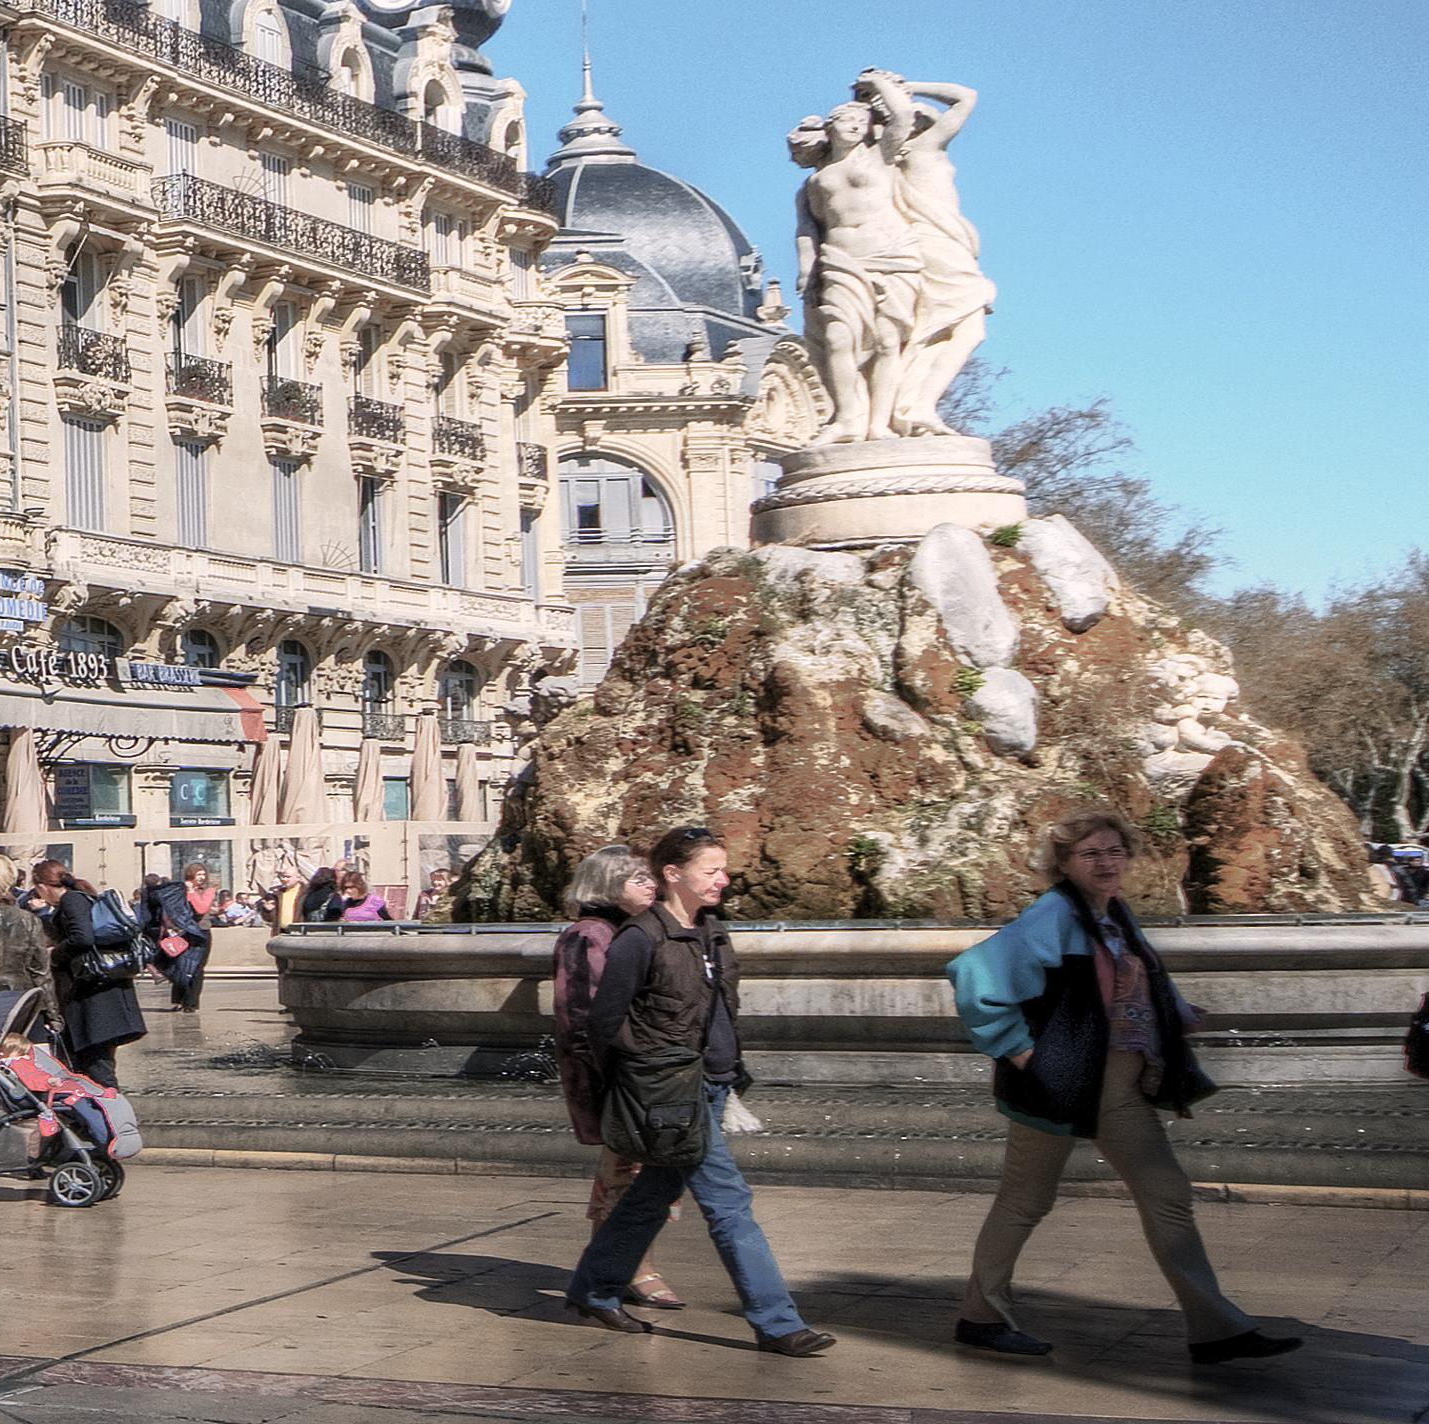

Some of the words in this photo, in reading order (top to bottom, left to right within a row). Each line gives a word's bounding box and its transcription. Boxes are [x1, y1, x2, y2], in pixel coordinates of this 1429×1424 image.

[11, 645, 60, 682] Café
[67, 651, 109, 680] 1893
[136, 664, 155, 682] BAR
